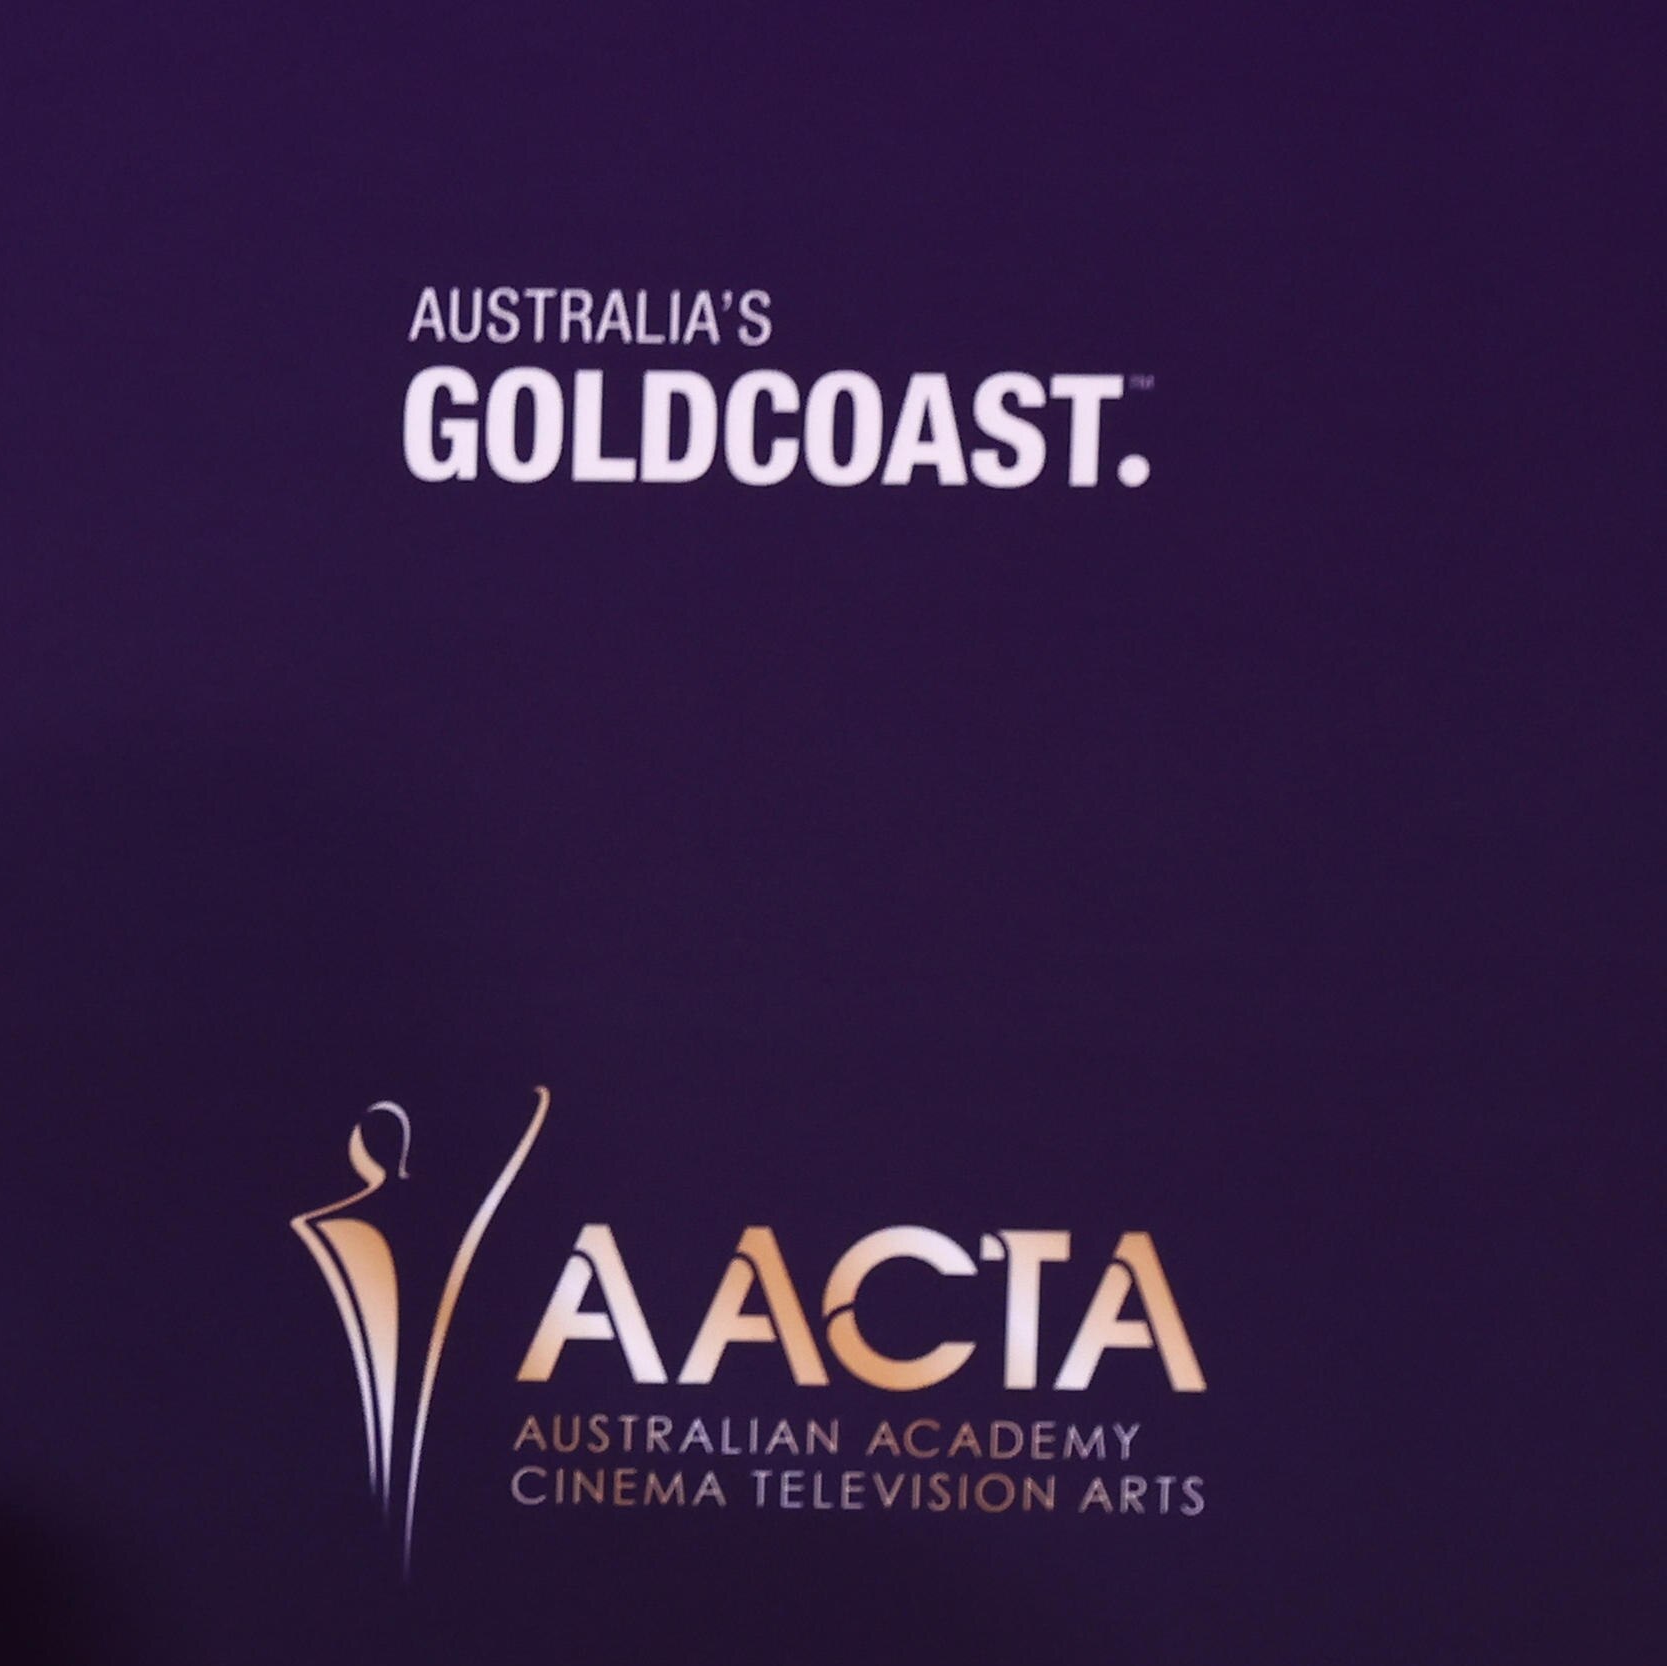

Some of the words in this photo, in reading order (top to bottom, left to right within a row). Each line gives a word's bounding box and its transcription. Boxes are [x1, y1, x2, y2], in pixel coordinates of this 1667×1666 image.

[408, 286, 773, 346] AUSTRALIA'S
[516, 1223, 1207, 1393] AACTA
[513, 1413, 840, 1456] AUSTRALIAN
[865, 1418, 1142, 1461] ACADEMY
[509, 1464, 728, 1508] CINEMA
[750, 1468, 1057, 1513] TELEVISION
[1078, 1474, 1206, 1517] ARTS
